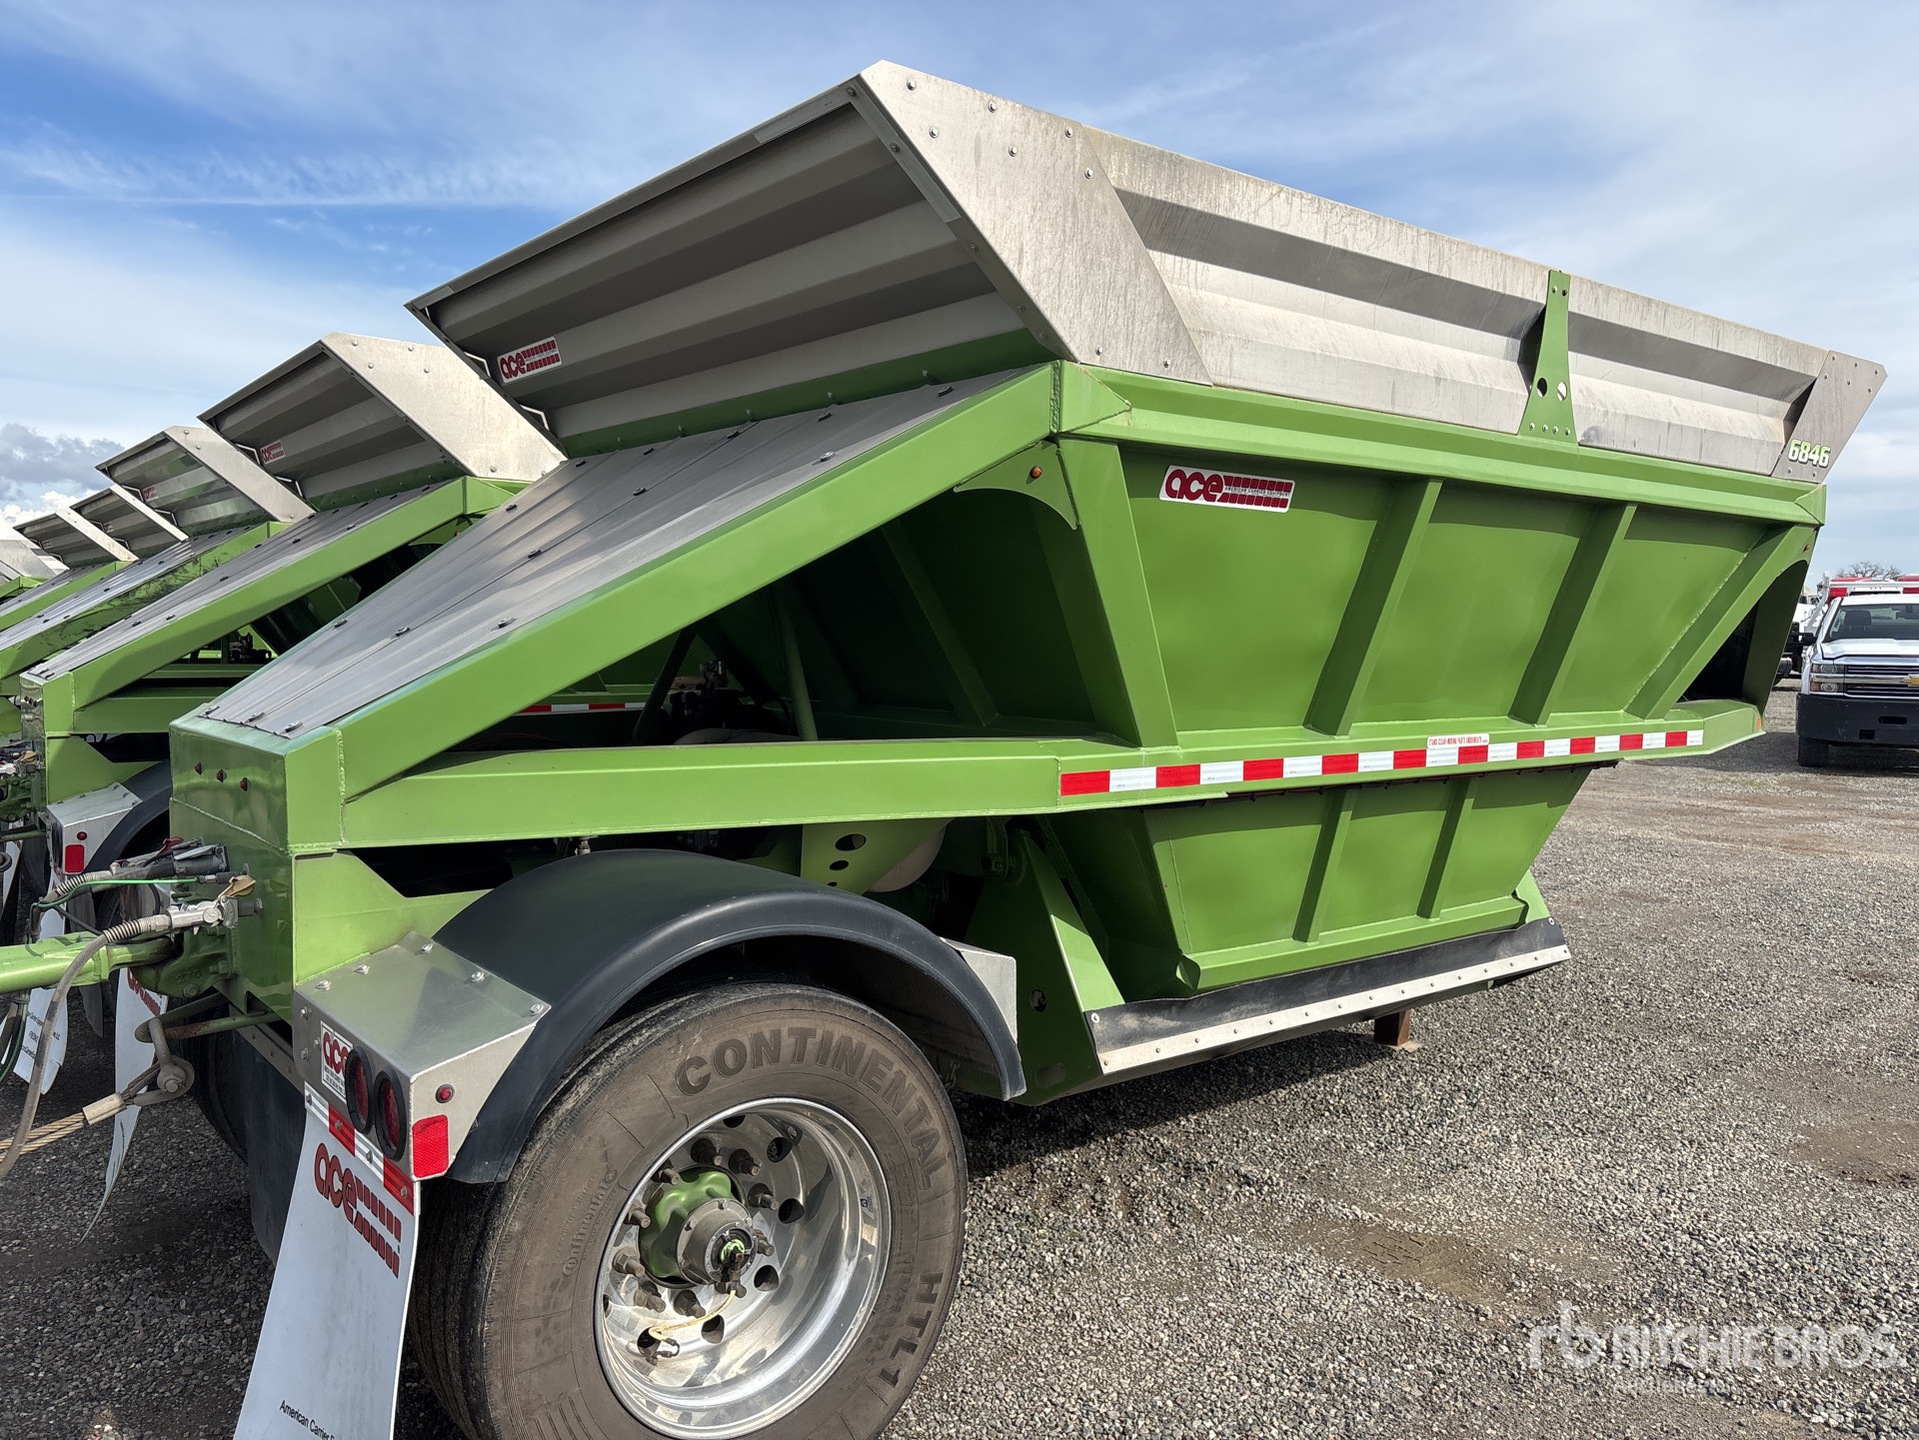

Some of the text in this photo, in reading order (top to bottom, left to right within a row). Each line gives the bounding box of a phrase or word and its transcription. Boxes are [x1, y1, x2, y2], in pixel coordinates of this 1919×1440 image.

[500, 352, 526, 379] ace
[1789, 439, 1831, 468] 6846
[1165, 468, 1224, 503] ace
[675, 1026, 949, 1191] CONTINENTAL
[314, 1142, 357, 1225] ace
[280, 1399, 309, 1429] American
